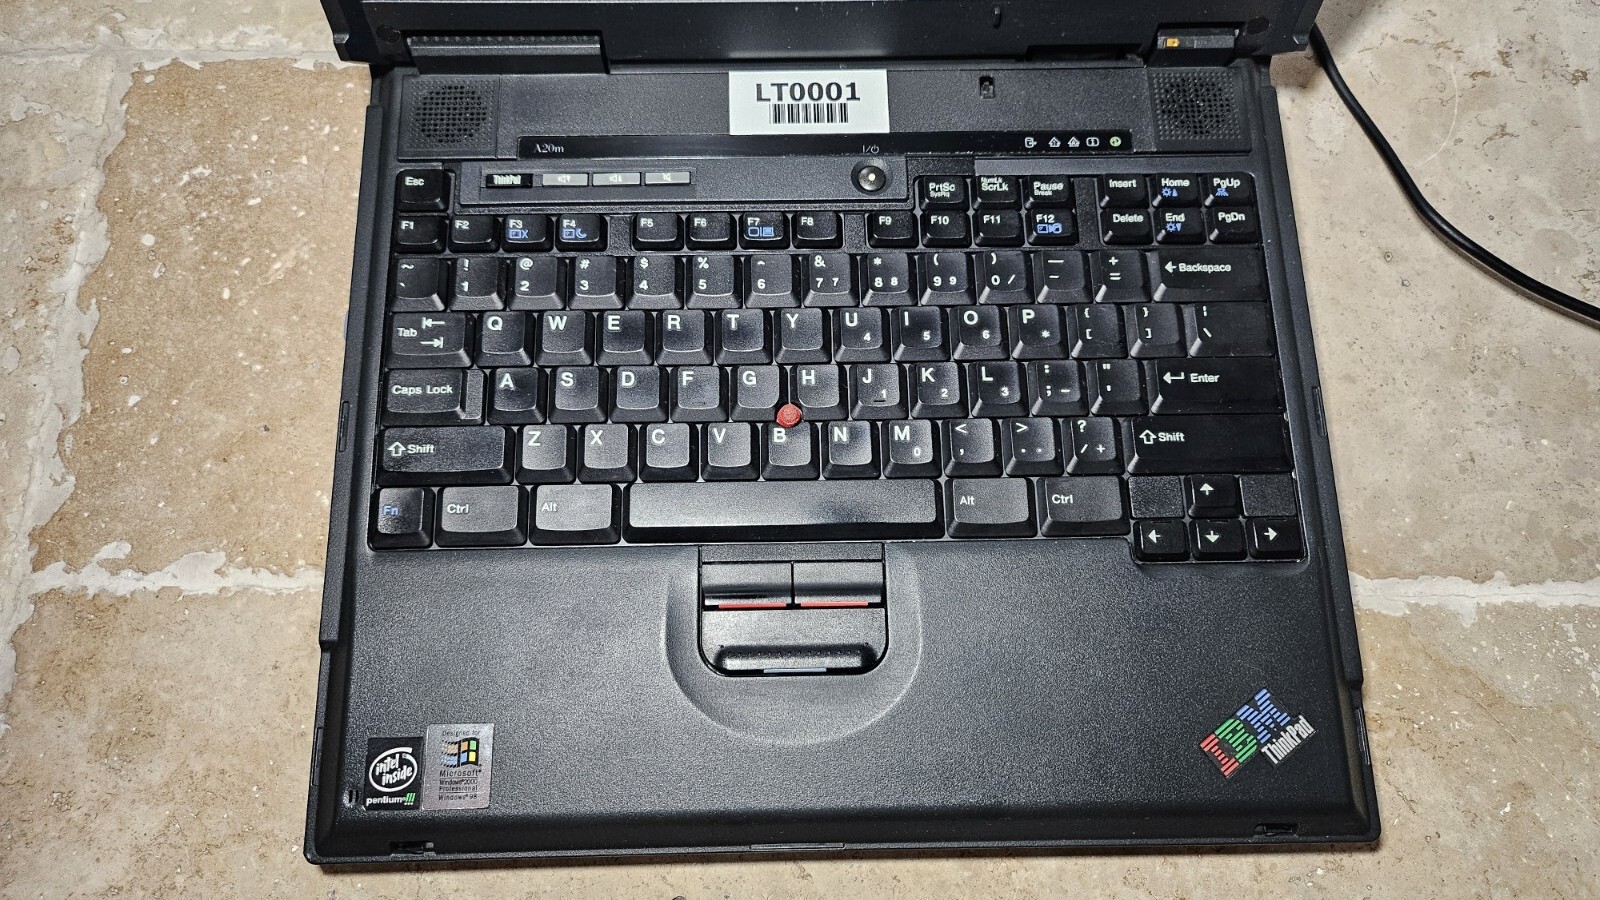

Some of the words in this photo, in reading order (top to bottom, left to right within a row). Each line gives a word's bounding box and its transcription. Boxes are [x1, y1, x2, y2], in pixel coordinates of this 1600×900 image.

[755, 82, 861, 102] LT0001
[533, 144, 564, 154] A20m
[405, 176, 424, 187] Esc
[929, 182, 956, 192] PrtSc
[981, 182, 1008, 192] ScrLk
[1033, 181, 1064, 191] Pause
[1109, 179, 1137, 188] Insert
[1161, 178, 1190, 188] Home
[1213, 178, 1241, 188] PgUp
[640, 218, 654, 228] F5
[694, 218, 707, 228] F6
[748, 217, 760, 226] F7
[801, 217, 814, 227] F8
[879, 216, 892, 225] F9
[930, 215, 949, 225] F10
[983, 215, 1001, 224] F11
[1036, 214, 1055, 223] F12
[1112, 213, 1144, 223] Delete
[1165, 213, 1185, 222] End
[1218, 212, 1246, 223] PgDn
[401, 221, 414, 230] F1
[455, 220, 470, 230] F2
[509, 219, 523, 229] F3
[563, 219, 576, 229] F4
[640, 258, 648, 269] $
[699, 257, 709, 269] %
[815, 256, 826, 268] &
[933, 253, 939, 266] (
[991, 252, 997, 265] )
[1109, 256, 1119, 266] +
[463, 259, 469, 271] !
[520, 259, 533, 270] @
[579, 259, 590, 270] #
[1178, 262, 1232, 273] Backspace
[580, 280, 589, 291] 3
[639, 280, 648, 291] 4
[698, 279, 707, 290] 5
[758, 279, 766, 289] 6
[816, 278, 824, 288] 7
[832, 278, 839, 287] 7
[874, 277, 883, 287] 8
[891, 277, 898, 286] 8
[933, 276, 942, 286] 9
[949, 276, 957, 285] 9
[991, 275, 1000, 285] 0
[462, 282, 469, 292] 1
[520, 281, 530, 292] 2
[727, 314, 740, 329] T
[786, 313, 799, 328] Y
[845, 312, 858, 327] U
[904, 311, 909, 326] I
[963, 310, 978, 325] O
[1022, 309, 1035, 324] P
[487, 316, 503, 331] Q
[549, 316, 567, 330] W
[608, 316, 620, 330] E
[667, 315, 681, 330] R
[397, 328, 418, 337] Tab
[863, 332, 871, 342] 4
[923, 331, 931, 341] 5
[983, 330, 991, 340] 6
[561, 372, 574, 387] S
[622, 371, 635, 386] D
[682, 371, 694, 386] F
[743, 370, 757, 385] G
[802, 370, 816, 385] H
[862, 368, 872, 384] J
[921, 367, 935, 383] K
[981, 367, 993, 382] L
[1190, 373, 1220, 384] Enter
[500, 373, 515, 388] A
[391, 385, 422, 396] Caps
[426, 384, 453, 394] Lock
[881, 390, 887, 398] 1
[941, 388, 949, 398] 2
[1001, 387, 1009, 397] 3
[1077, 420, 1087, 433] ?
[528, 431, 541, 446] Z
[590, 430, 603, 445] X
[652, 429, 666, 444] C
[713, 428, 726, 443] V
[773, 427, 787, 443] B
[833, 427, 847, 442] N
[894, 426, 910, 441] M
[1158, 432, 1185, 442] Shift
[407, 444, 435, 454] Shift
[959, 495, 975, 506] Alt
[1051, 493, 1073, 504] Ctrl
[383, 505, 399, 516] Fn
[447, 503, 469, 514] Ctrl
[541, 502, 557, 513] Alt
[1200, 688, 1291, 778] IBM
[1260, 714, 1316, 764] ThinkPad
[375, 753, 400, 776] intel
[382, 765, 413, 786] inside
